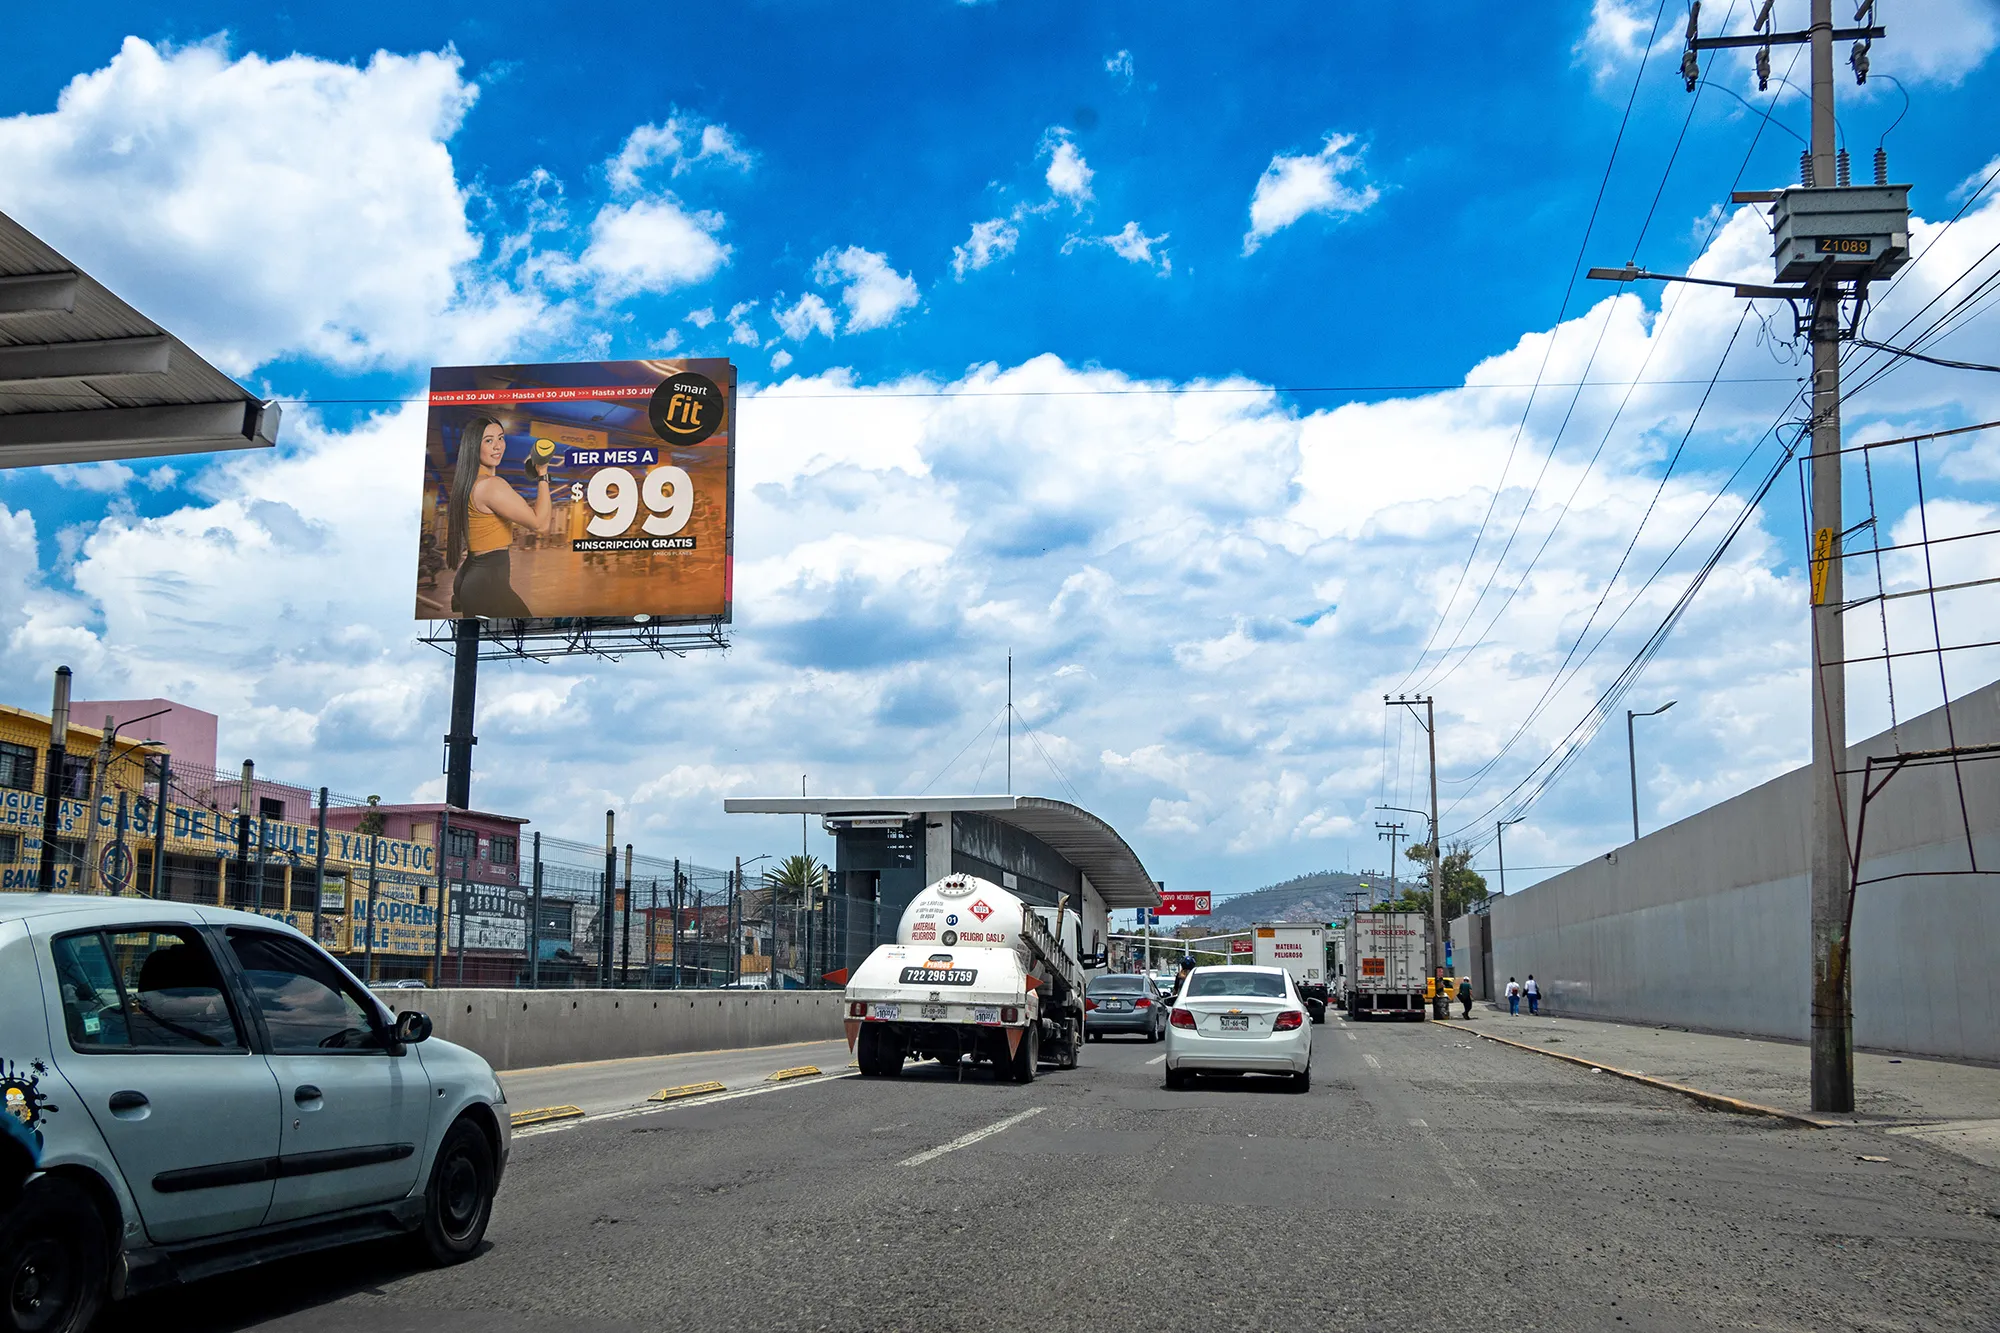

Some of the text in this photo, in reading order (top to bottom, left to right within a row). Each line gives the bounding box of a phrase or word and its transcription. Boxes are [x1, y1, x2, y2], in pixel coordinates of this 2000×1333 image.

[1821, 239, 1868, 253] Z1089
[559, 390, 576, 398] JUN
[592, 389, 616, 397] Hasta
[617, 388, 625, 396] el
[639, 387, 656, 395] JUN
[673, 383, 708, 396] smart
[666, 393, 703, 426] fit
[572, 450, 654, 465] 1ER MES A
[575, 538, 693, 551] +INSCRIPCIÓN GRATIS
[173, 807, 207, 840] DE
[912, 922, 937, 932] MATERIAL
[911, 931, 937, 941] PELIGROSO
[960, 931, 984, 942] PELIGRO
[926, 961, 951, 969] PEDIDOS
[907, 969, 973, 982] 722 296 5759
